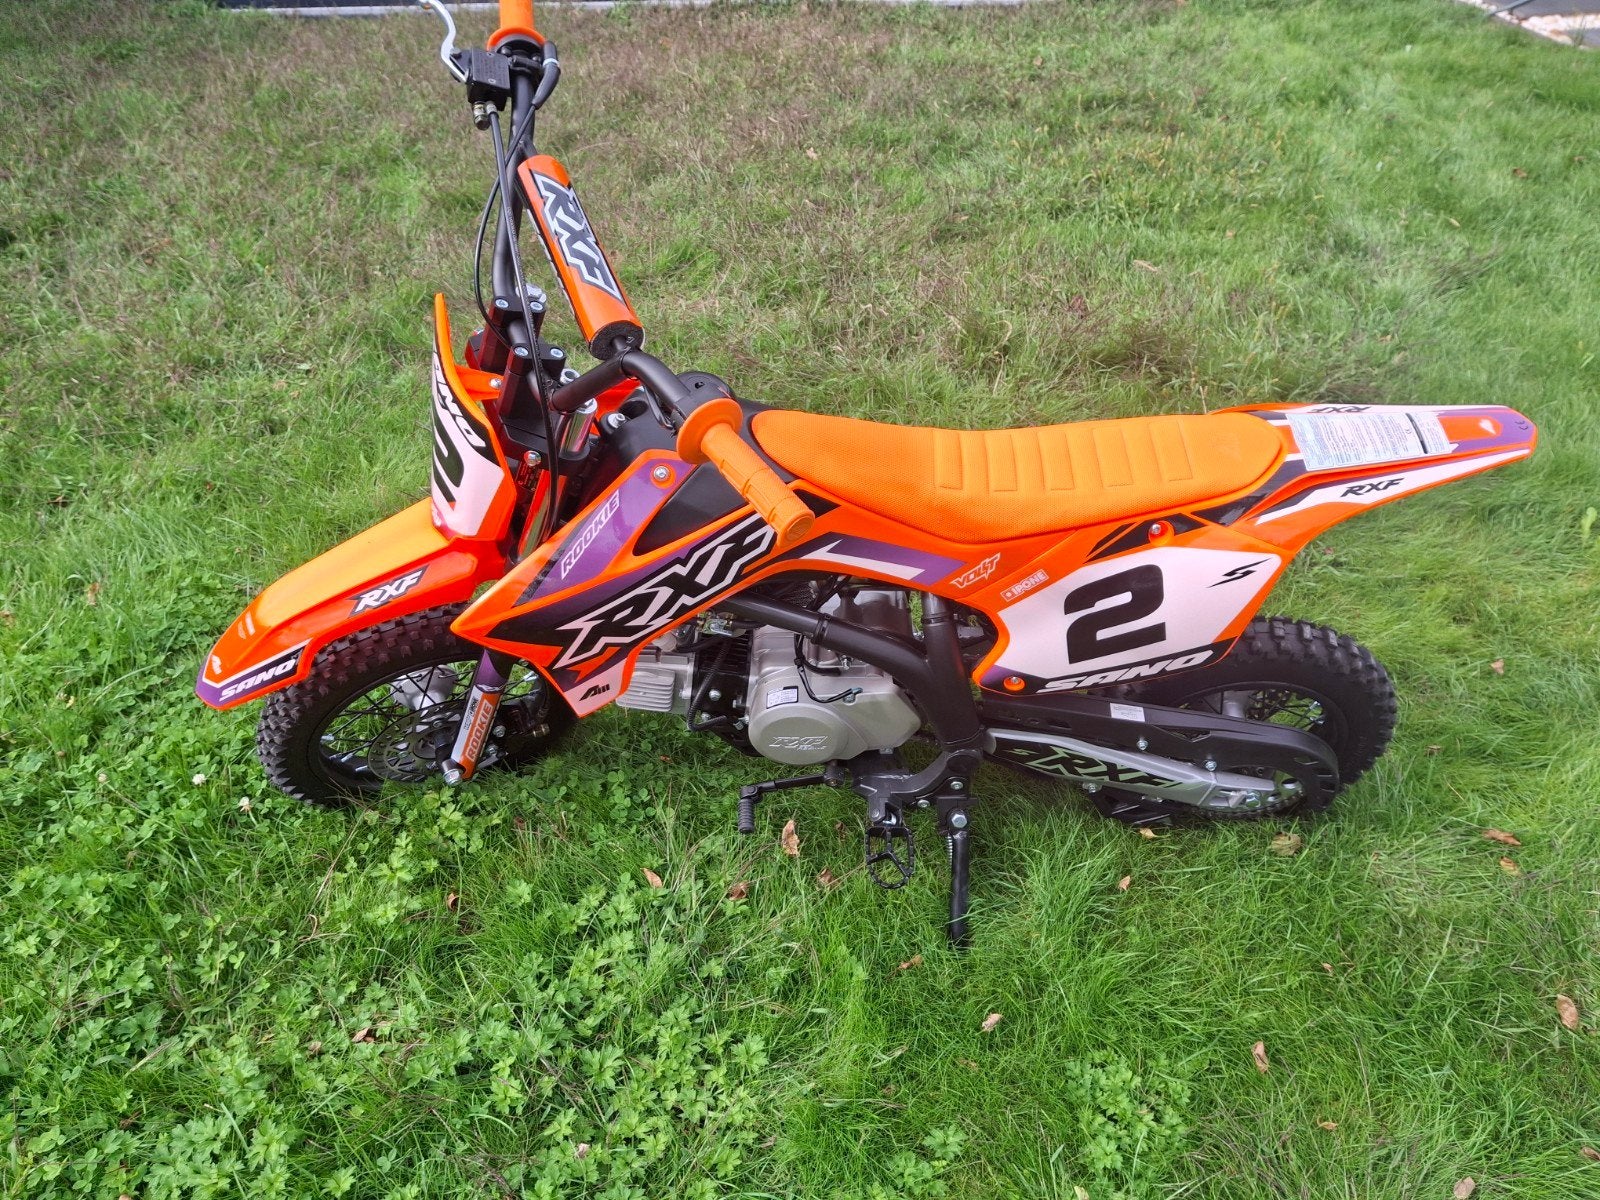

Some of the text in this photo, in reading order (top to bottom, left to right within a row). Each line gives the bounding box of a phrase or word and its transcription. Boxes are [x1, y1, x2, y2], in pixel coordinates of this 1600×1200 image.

[534, 172, 623, 303] RXF
[1340, 477, 1404, 498] RXF
[560, 490, 622, 580] ROOKIE
[353, 569, 423, 614] RXF
[552, 512, 776, 670] RXF
[950, 552, 1001, 589] VOLT
[1010, 571, 1047, 597] IPONE
[1063, 563, 1168, 665] 2
[218, 658, 297, 703] SANO
[1035, 648, 1215, 695] SANO
[466, 699, 494, 762] ROOKIE
